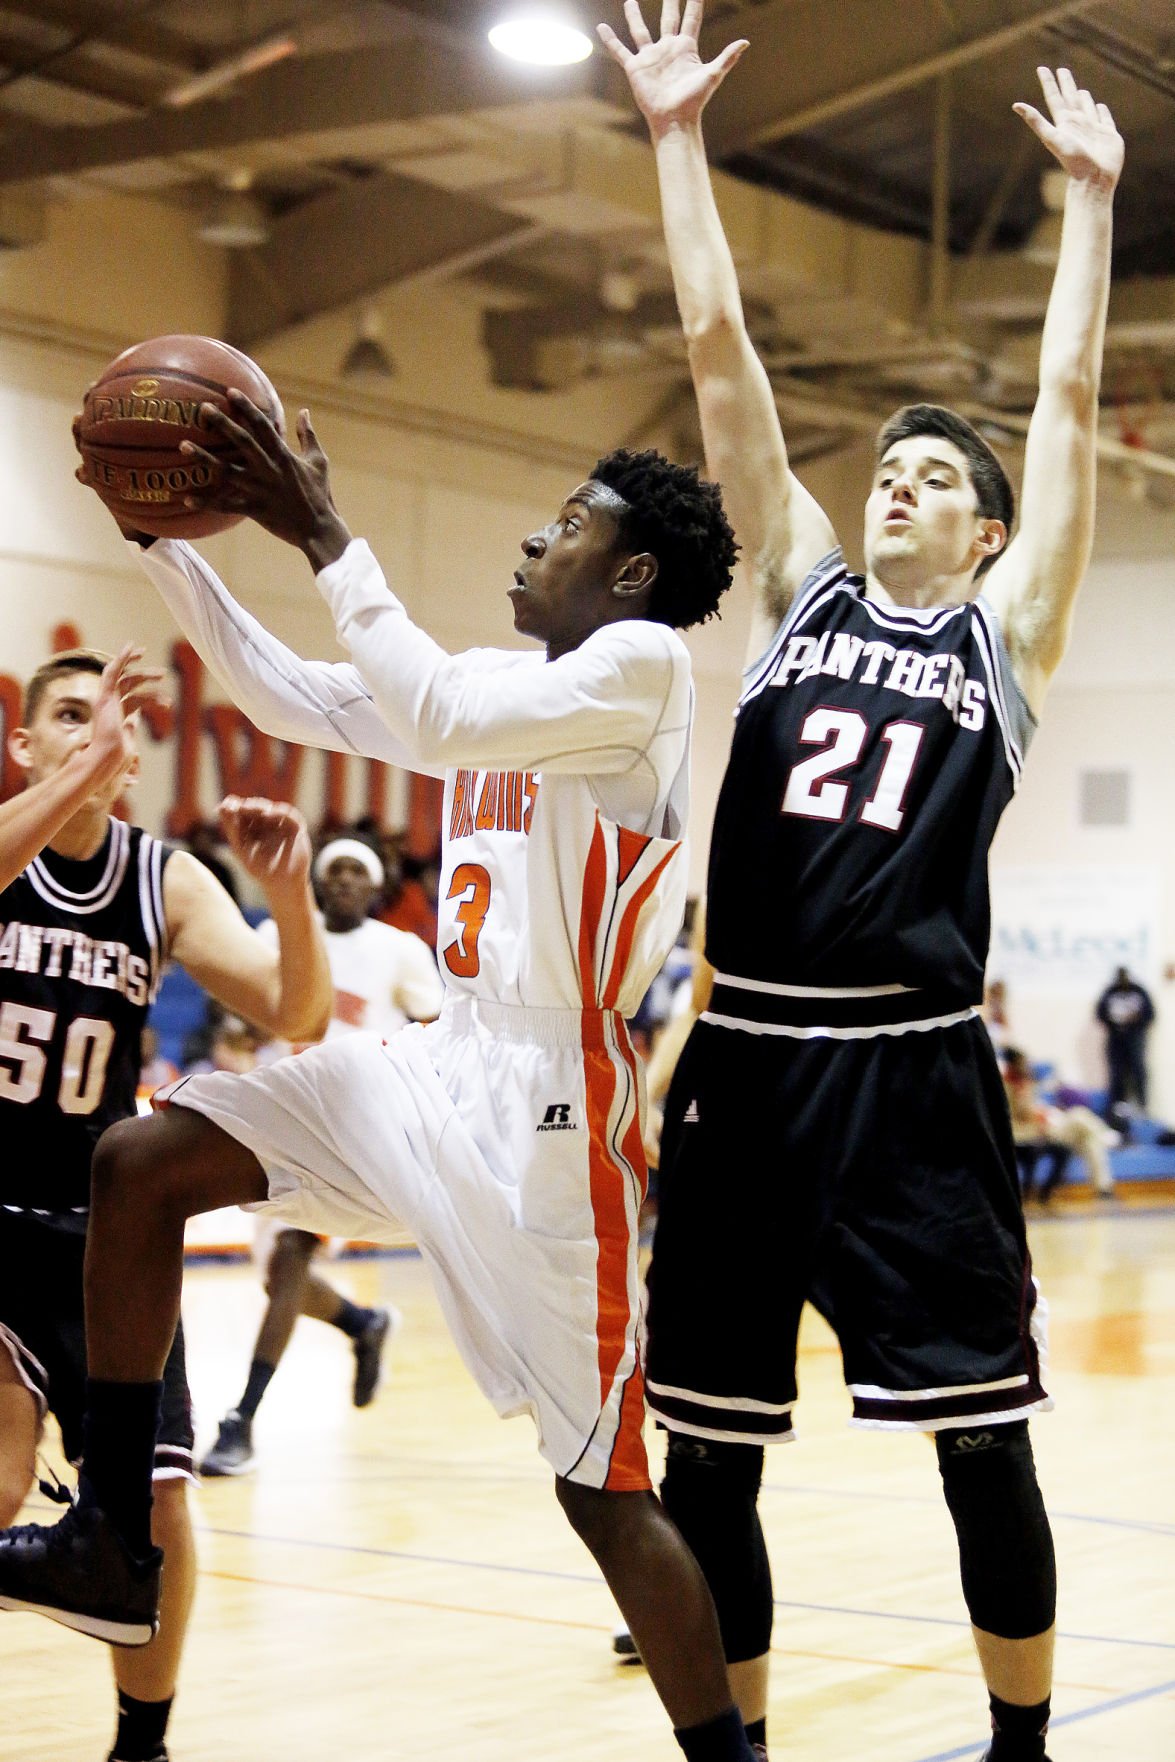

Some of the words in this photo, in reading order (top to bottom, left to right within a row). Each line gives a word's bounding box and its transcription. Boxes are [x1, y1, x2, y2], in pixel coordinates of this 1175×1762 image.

[768, 630, 986, 732] PANTHERS
[780, 704, 928, 836] 21
[443, 863, 492, 978] 3
[0, 1001, 116, 1115] 50
[536, 1123, 578, 1132] RUSSELL
